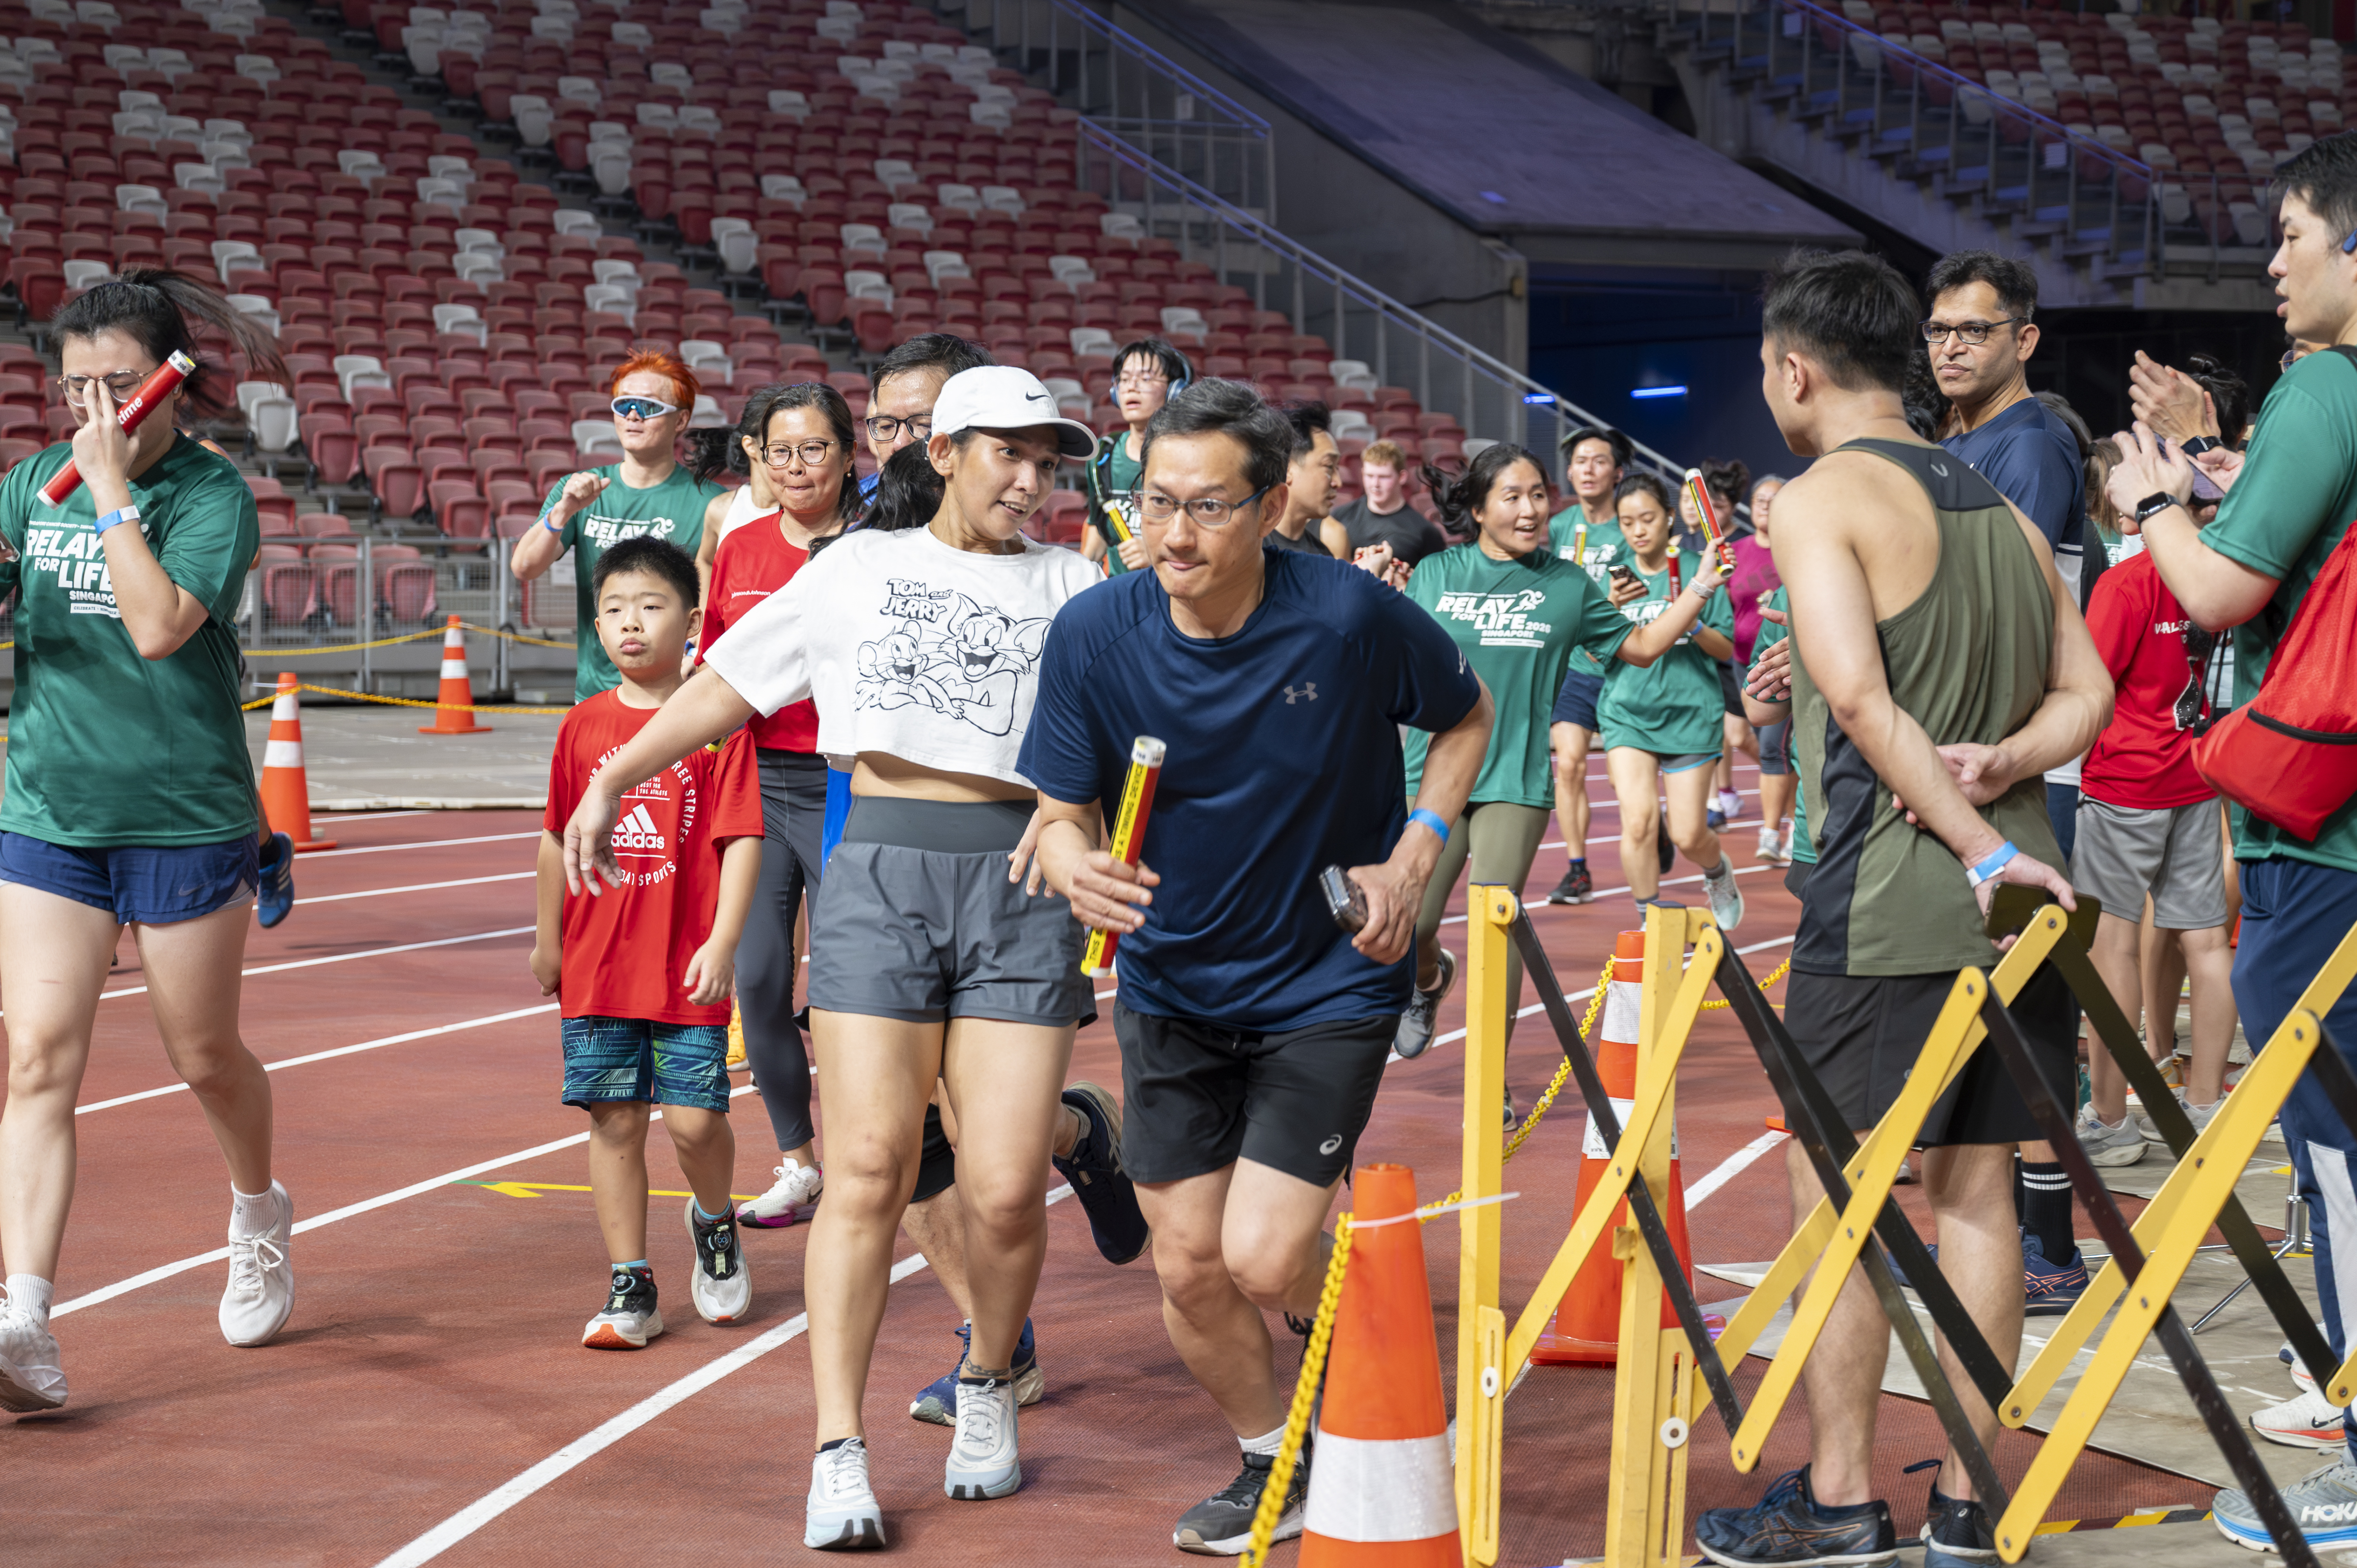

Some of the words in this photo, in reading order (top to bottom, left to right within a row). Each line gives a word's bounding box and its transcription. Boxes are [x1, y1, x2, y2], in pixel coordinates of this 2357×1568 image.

[584, 518, 649, 540] RELAY
[26, 528, 103, 560] RELAY
[34, 557, 60, 572] FOR
[69, 590, 116, 605] SINGAPO
[886, 578, 926, 597] TOM
[928, 589, 953, 600] and
[879, 596, 948, 623] JERRY
[1434, 595, 1516, 615] RELAY
[1451, 612, 1478, 621] FOR
[1473, 613, 1528, 630] LIFE
[1481, 629, 1535, 638] SINGAPORE
[678, 789, 697, 844] STRIPES
[611, 832, 665, 849] adidas
[638, 861, 677, 887] SPORTS
[2300, 1501, 2357, 1521] HOK
